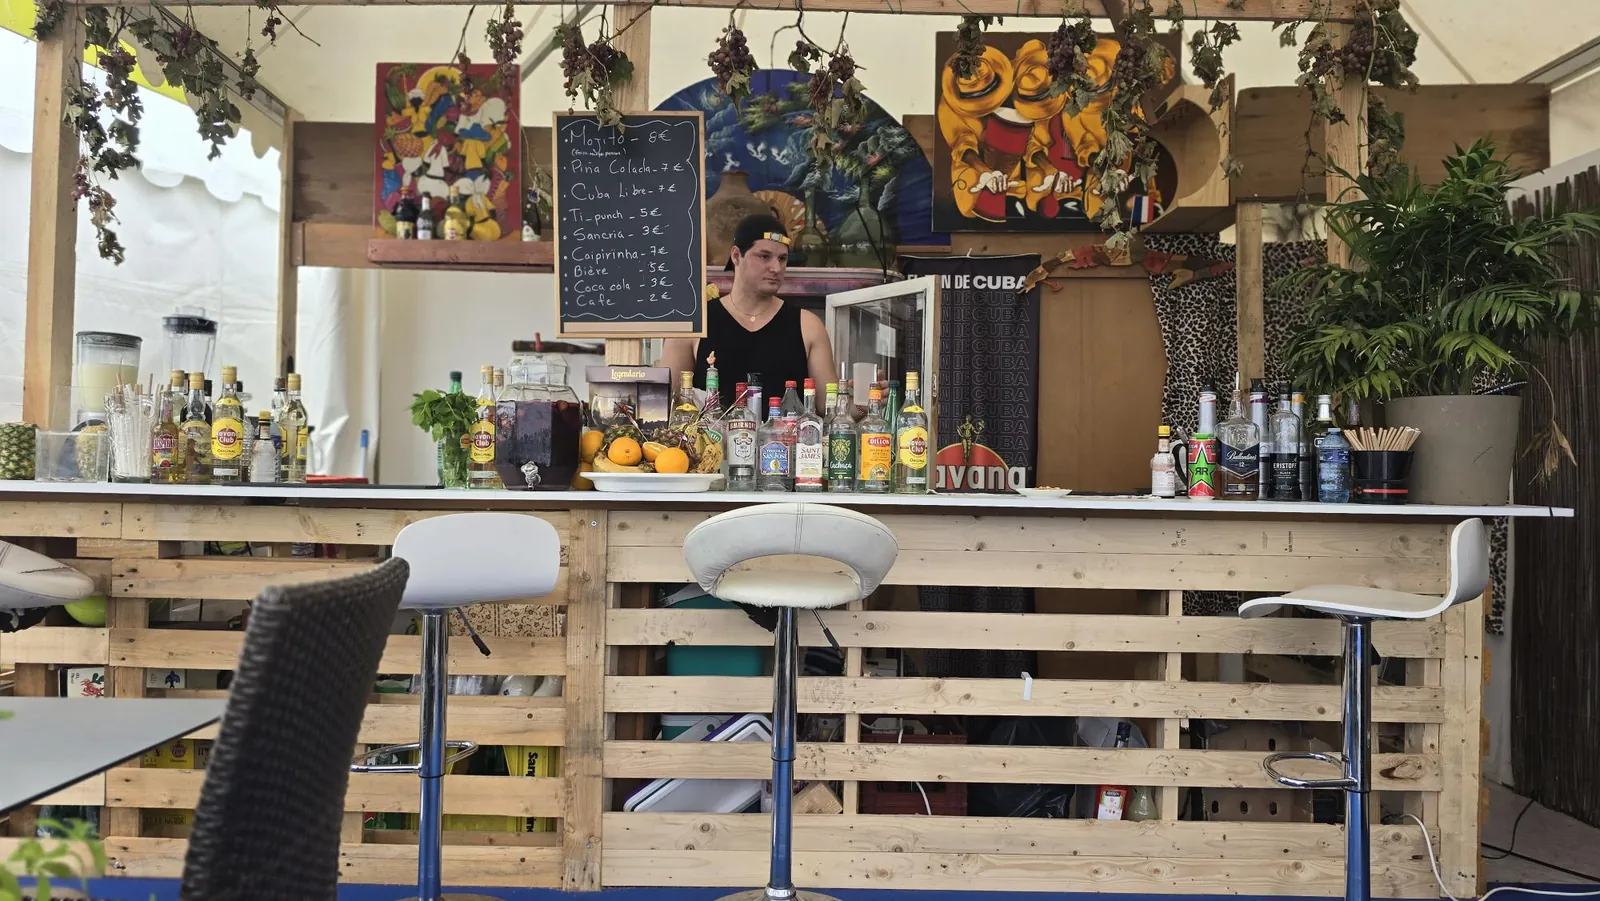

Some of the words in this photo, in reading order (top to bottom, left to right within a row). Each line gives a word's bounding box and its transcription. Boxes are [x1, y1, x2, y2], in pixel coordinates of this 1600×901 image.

[571, 183, 610, 200] Cuba
[573, 280, 605, 293] Coca
[954, 275, 970, 289] DE
[611, 368, 646, 380] Legendario
[936, 465, 1026, 490] avana
